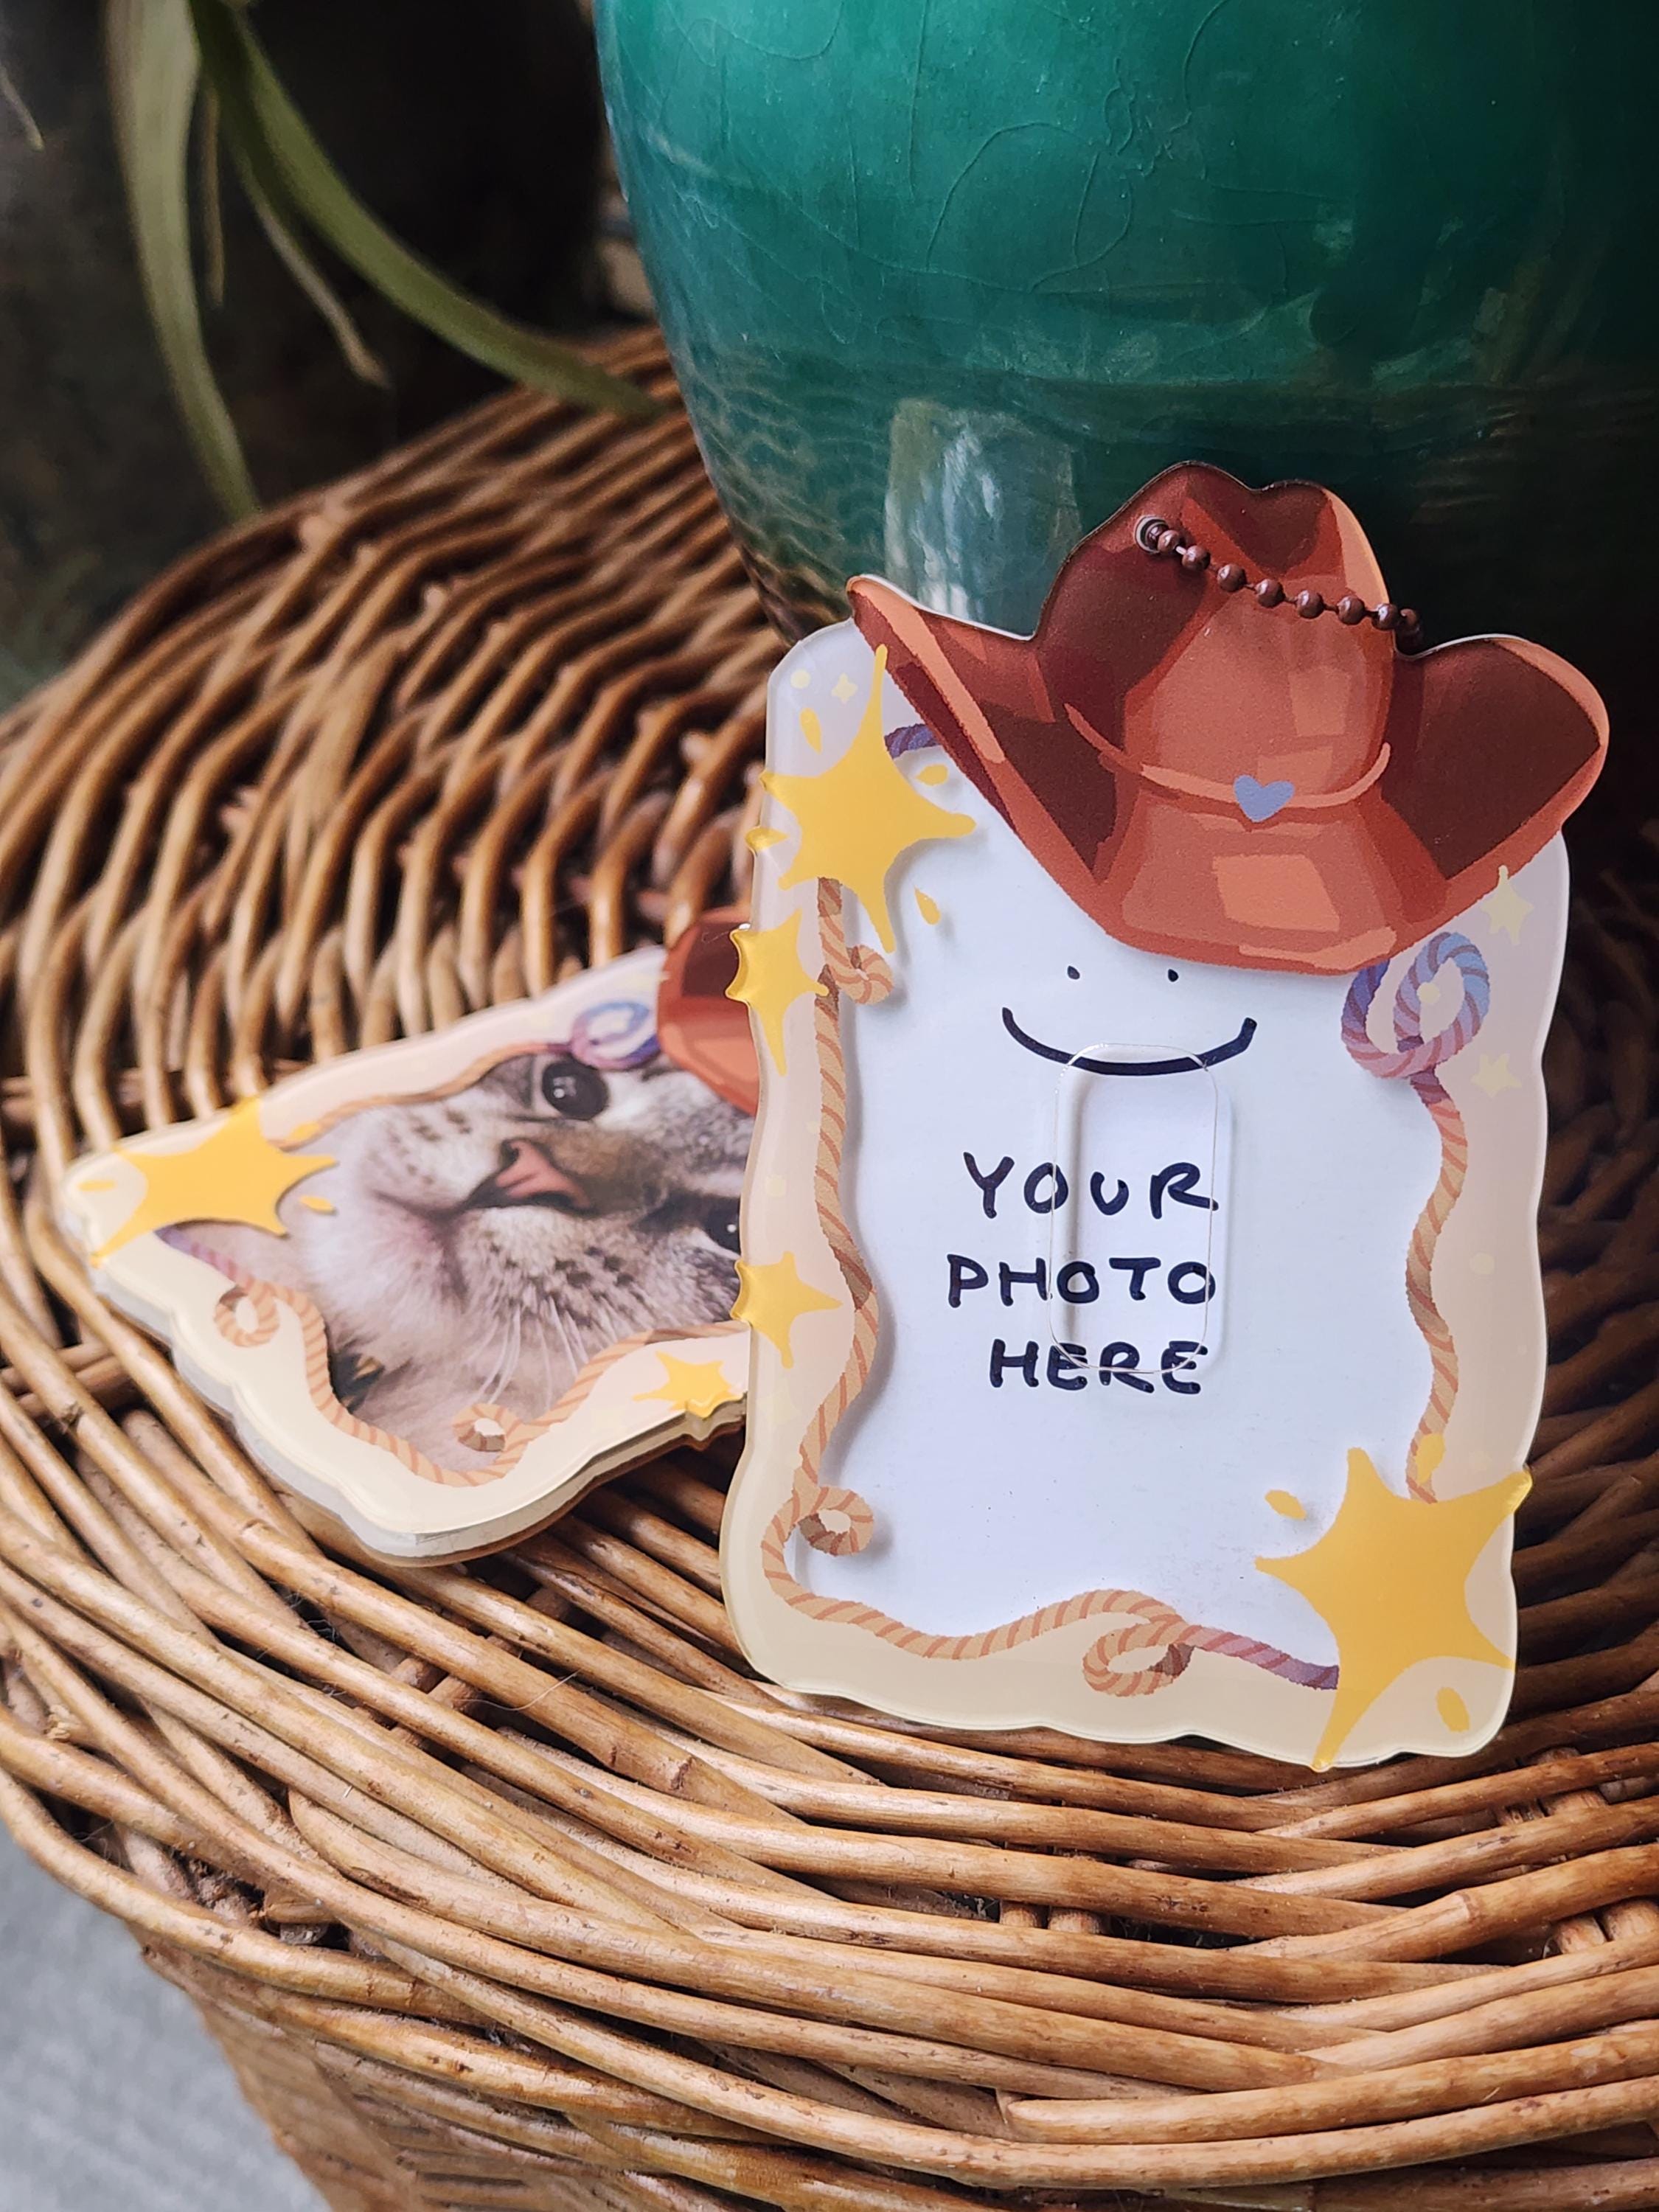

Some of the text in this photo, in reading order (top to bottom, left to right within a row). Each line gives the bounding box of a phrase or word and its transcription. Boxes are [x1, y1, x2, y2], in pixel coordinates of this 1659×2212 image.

[963, 1152, 1219, 1220] YOUR
[947, 1253, 1216, 1308] PHOTO
[990, 1338, 1208, 1395] HERE
